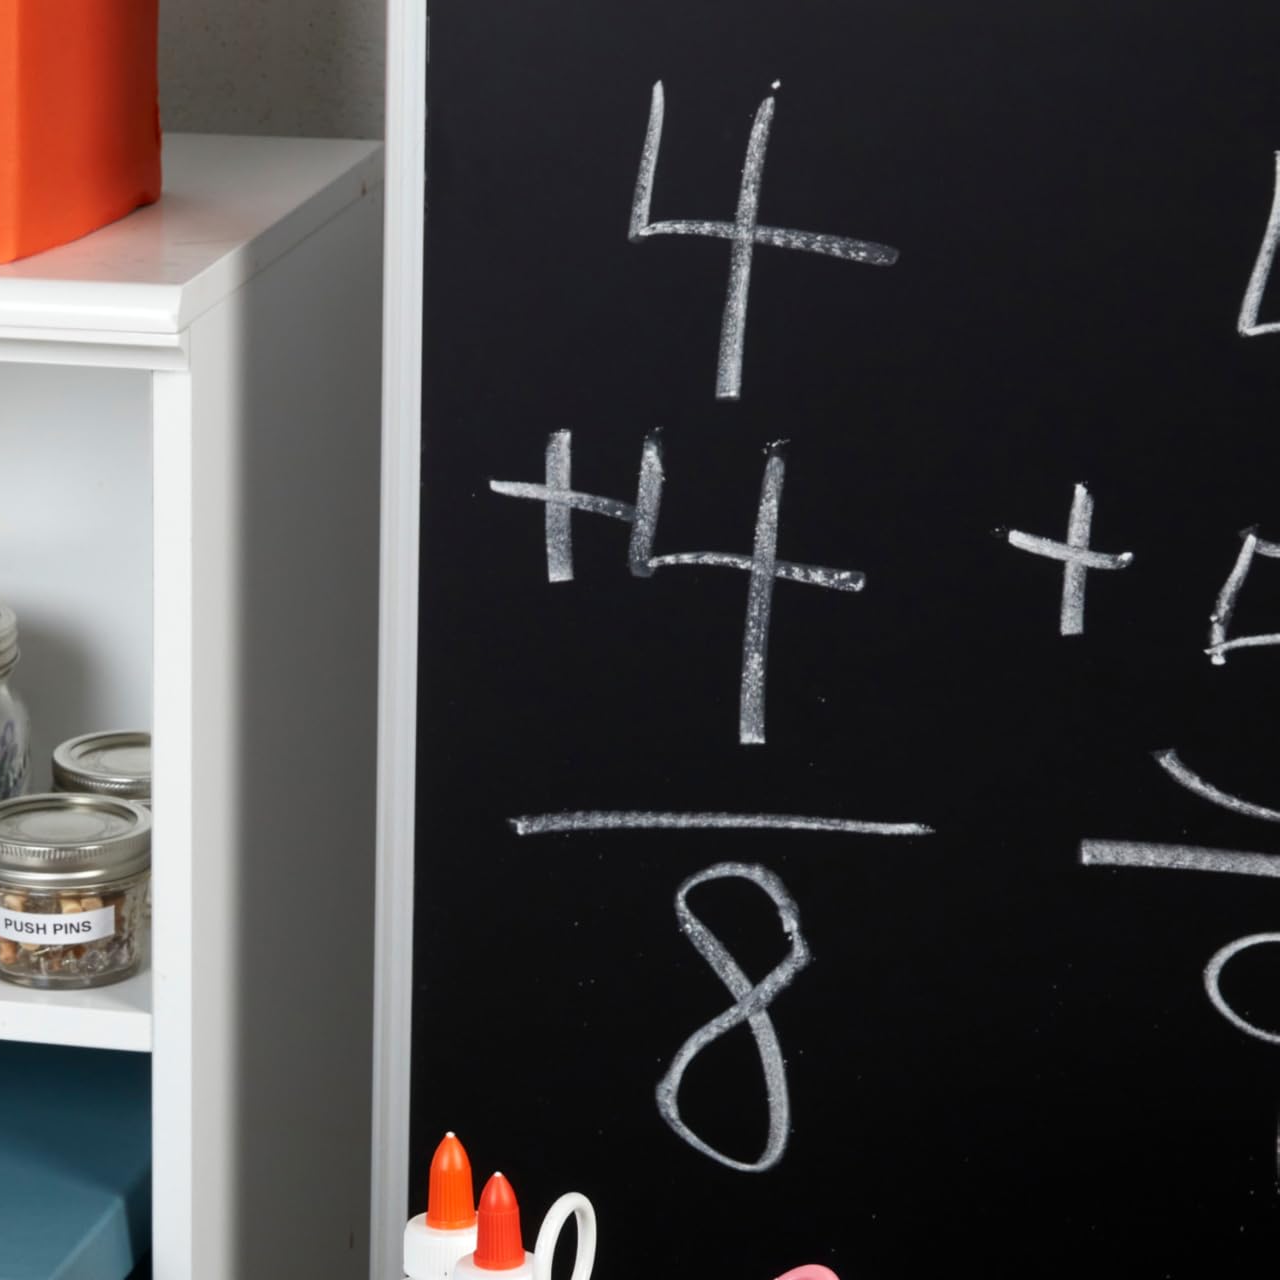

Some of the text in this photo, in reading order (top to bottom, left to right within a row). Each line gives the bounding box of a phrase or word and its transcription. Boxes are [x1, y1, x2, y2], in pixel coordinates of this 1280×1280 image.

[628, 79, 900, 400] 4
[4, 918, 92, 935] PUSH PINS
[656, 861, 810, 1173] 8
